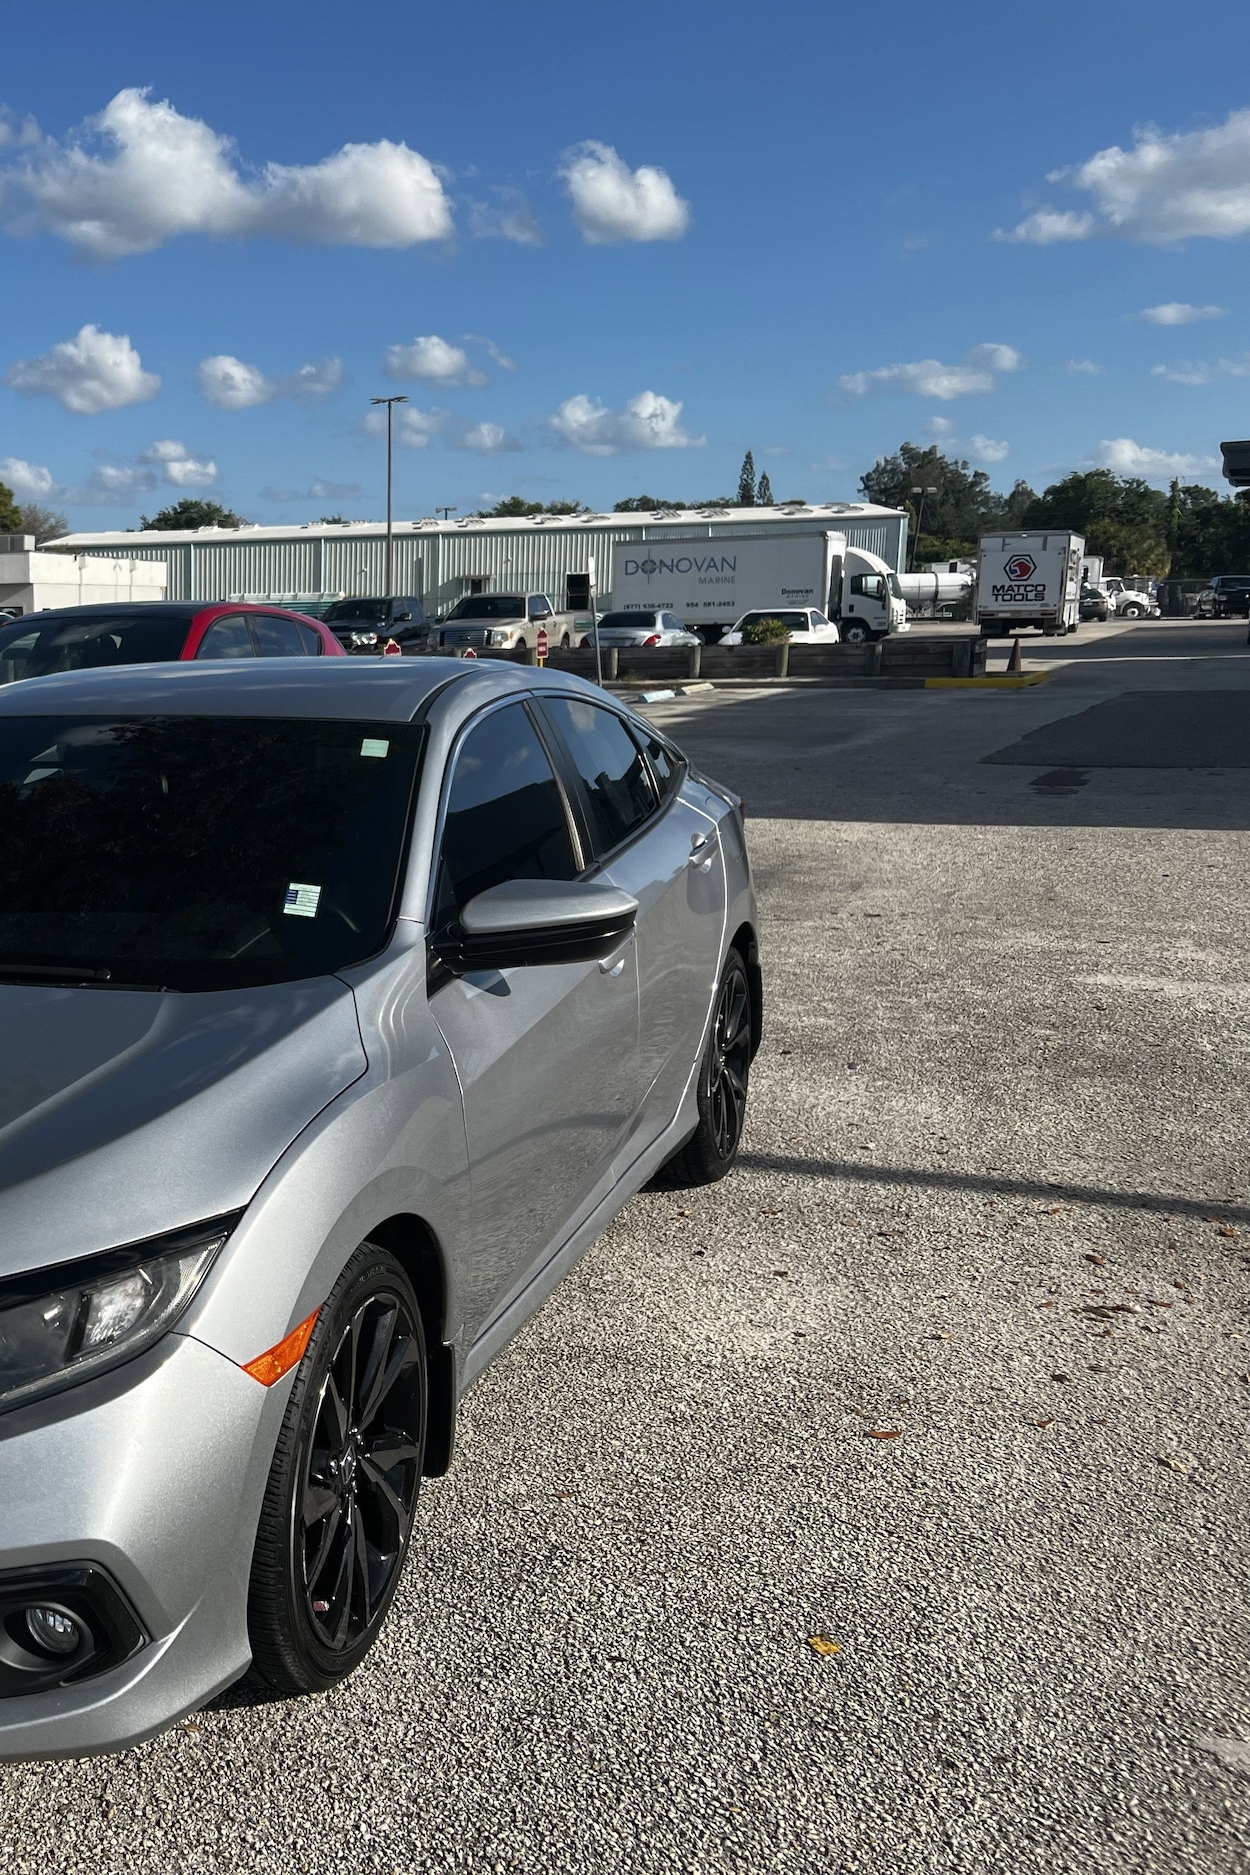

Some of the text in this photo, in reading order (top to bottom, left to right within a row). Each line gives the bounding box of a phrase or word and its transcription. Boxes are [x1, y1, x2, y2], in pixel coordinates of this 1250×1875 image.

[624, 555, 737, 577] DONOVAN
[698, 575, 736, 585] MARINE
[781, 588, 814, 596] Donovan
[991, 583, 1047, 593] MATCO
[991, 593, 1046, 603] TOOLS
